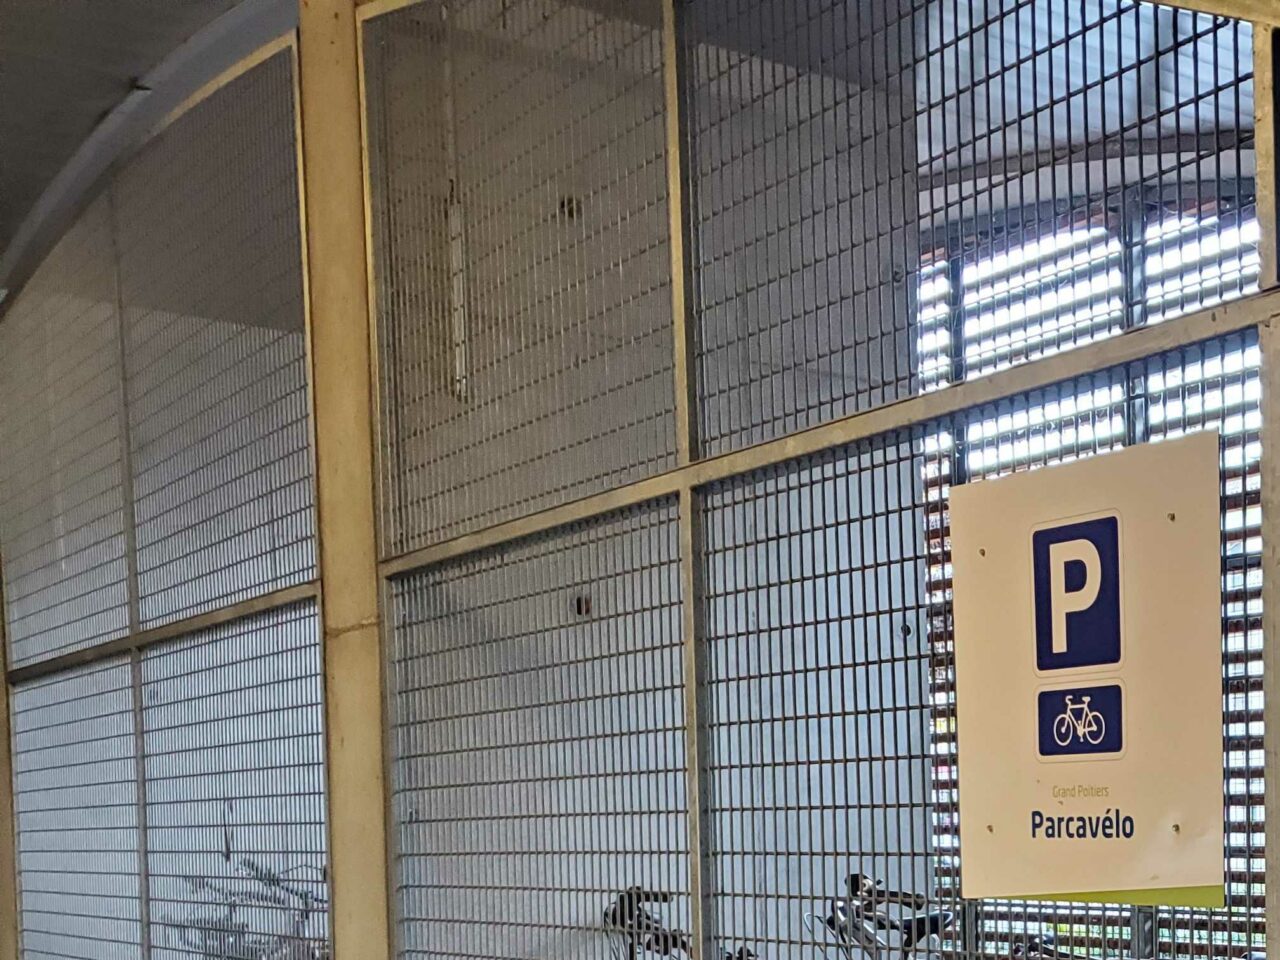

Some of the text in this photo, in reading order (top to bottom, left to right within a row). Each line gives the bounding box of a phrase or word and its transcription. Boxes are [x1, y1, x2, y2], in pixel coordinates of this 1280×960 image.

[1048, 538, 1102, 654] P
[1052, 785, 1110, 798] Grand Poitiers
[1031, 808, 1135, 839] Parcavélo
